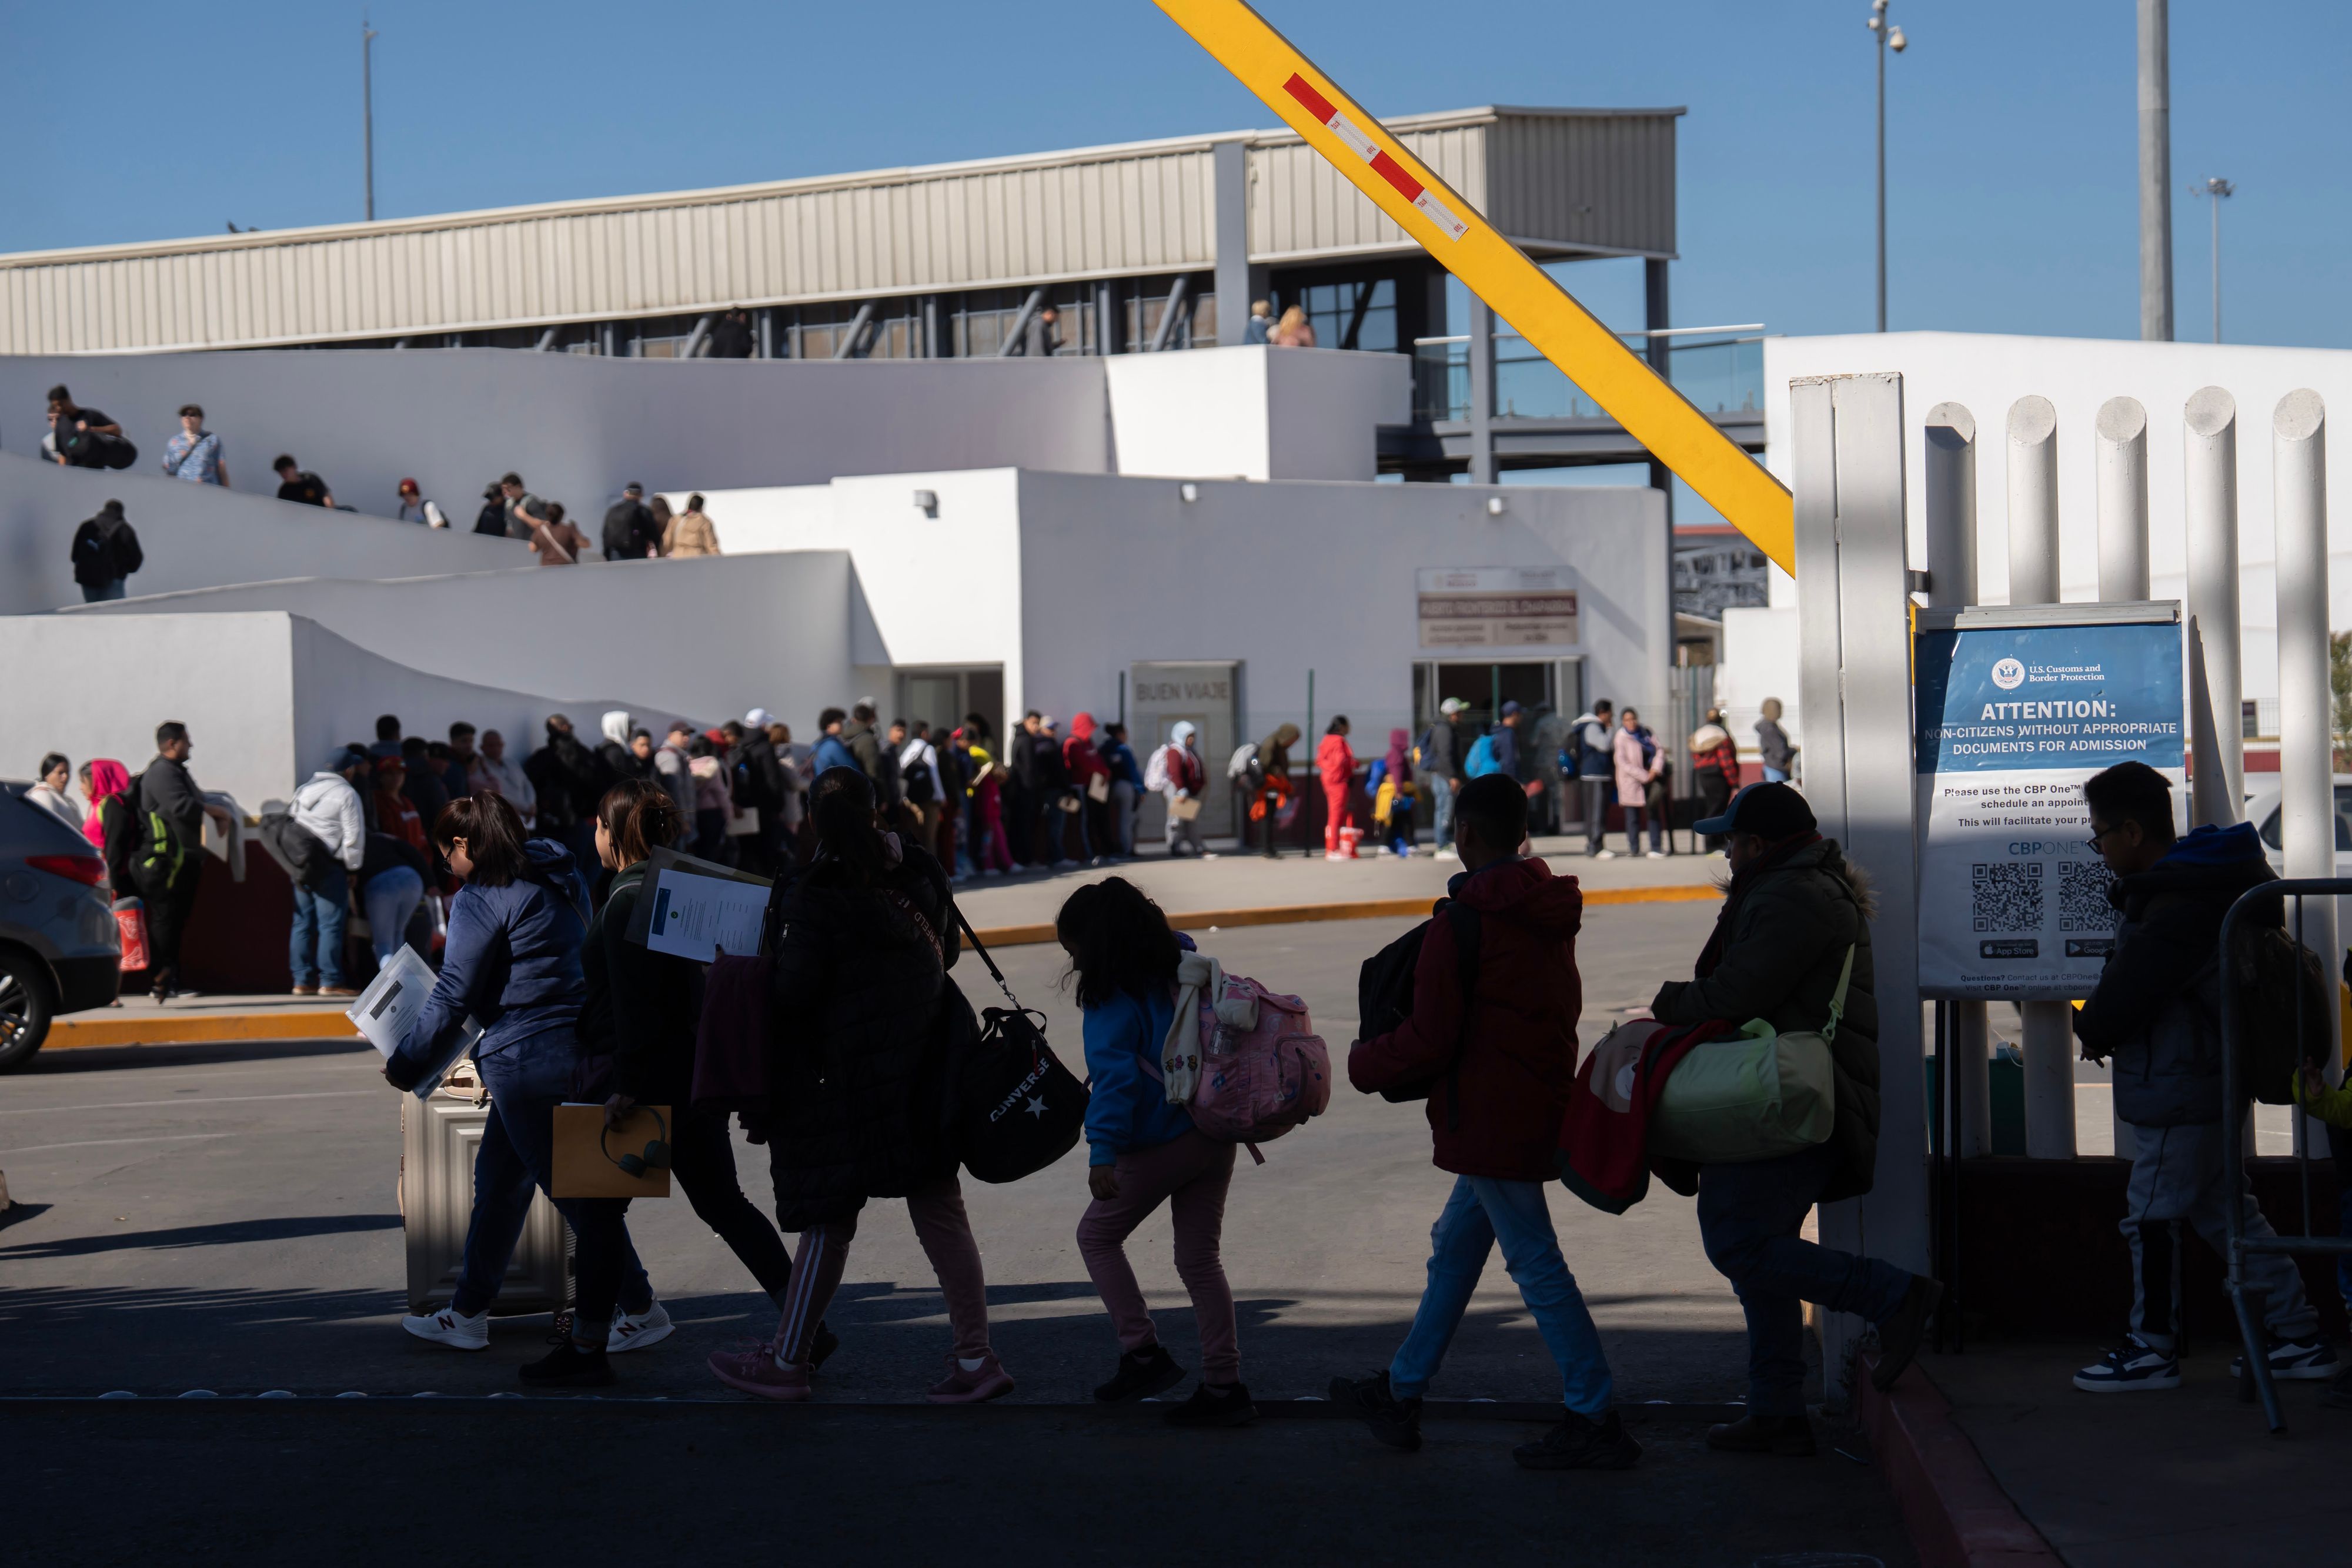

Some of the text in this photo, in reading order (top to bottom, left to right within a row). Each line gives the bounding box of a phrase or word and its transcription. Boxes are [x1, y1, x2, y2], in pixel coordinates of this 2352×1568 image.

[1980, 700, 2116, 721] ATTENTION:
[1925, 723, 2177, 740] NON-CITIZENS WITHOUT APPROPRIATE
[1953, 739, 2147, 755] DOCUMENTS FOR ADMISSION
[1944, 788, 1979, 797] Please
[2003, 786, 2021, 794] the
[2024, 785, 2047, 794] CBP
[1981, 799, 2028, 808] schedule
[2047, 797, 2090, 808] appoint
[1958, 818, 1980, 827] This
[1982, 817, 2000, 826] will
[2004, 816, 2052, 825] facilitate
[2055, 816, 2077, 826] your
[1996, 947, 2034, 956] App Store
[1960, 974, 2005, 982] Questions?
[990, 1057, 1050, 1123] CONVERSE
